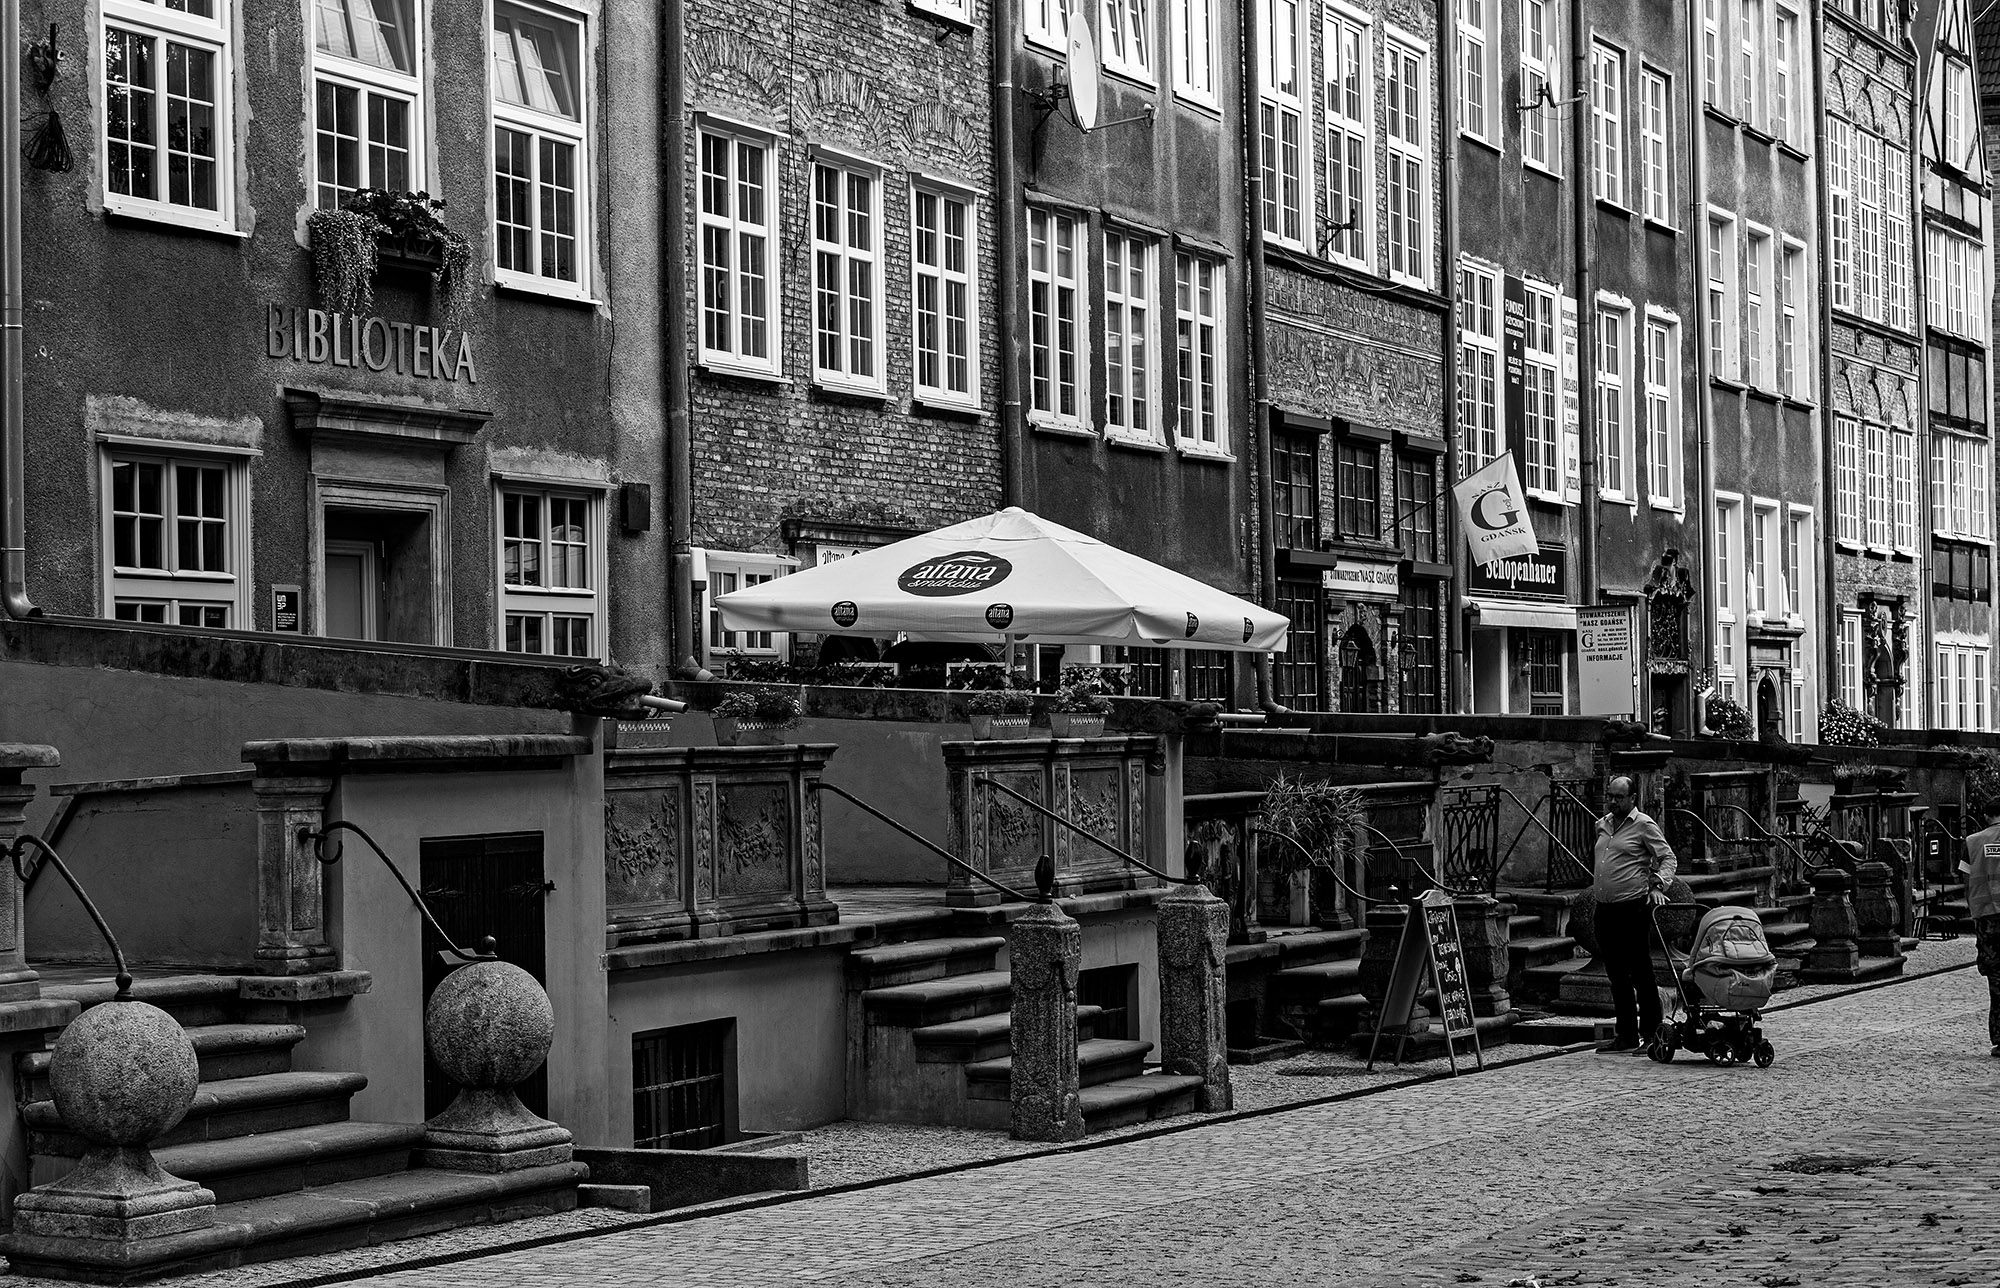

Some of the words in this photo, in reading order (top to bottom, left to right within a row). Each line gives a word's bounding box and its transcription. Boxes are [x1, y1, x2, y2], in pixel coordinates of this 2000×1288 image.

[1505, 299, 1524, 317] FUNDUSZ
[268, 301, 478, 384] BIBLIOTEKA
[1471, 481, 1501, 499] NASZ
[1470, 483, 1520, 530] G
[1480, 527, 1527, 543] GDAŃSK
[1485, 553, 1556, 589] Schopenhauer
